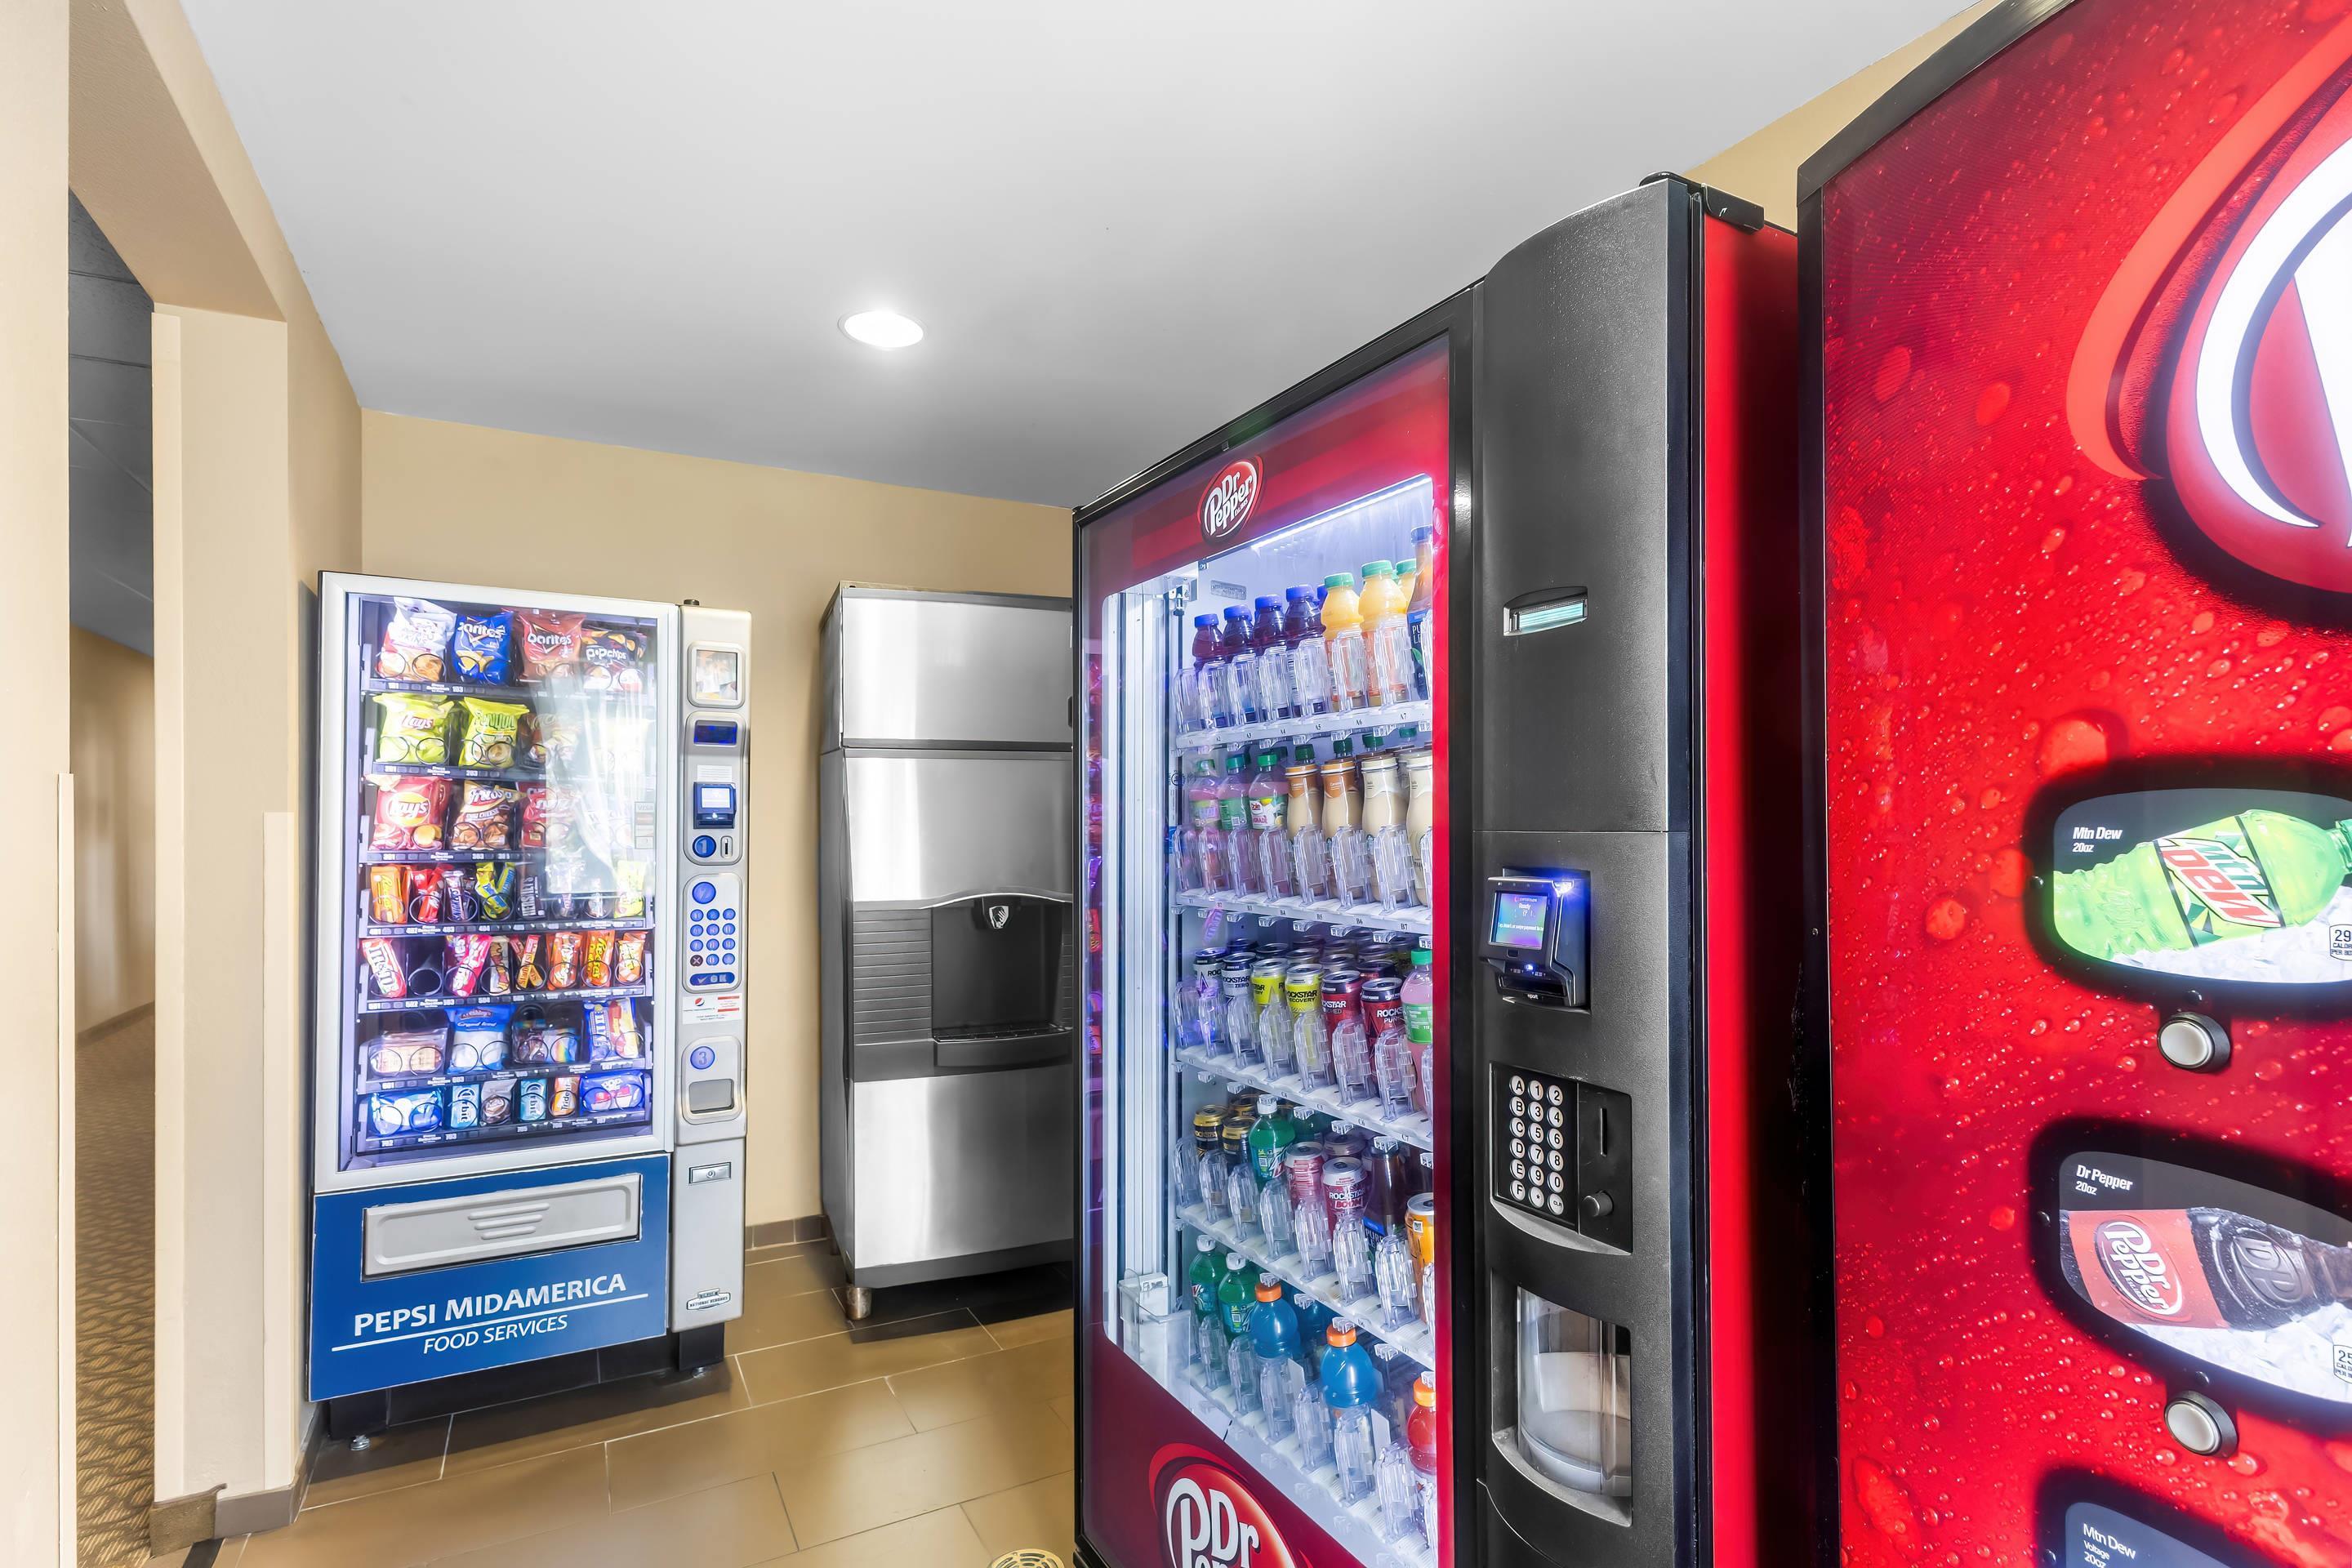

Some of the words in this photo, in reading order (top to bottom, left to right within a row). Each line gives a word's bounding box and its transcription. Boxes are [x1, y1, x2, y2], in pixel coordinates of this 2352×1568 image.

[1222, 472, 1241, 506] Dr
[1205, 475, 1253, 536] Pepper
[528, 633, 572, 646] Doritos
[2072, 826, 2095, 840] Mtn
[2096, 826, 2123, 840] Dew
[2072, 842, 2095, 853] 20oz
[1519, 902, 1531, 911] Ready
[698, 1051, 707, 1066] 3
[1516, 1080, 1523, 1091] A
[1535, 1085, 1539, 1096] 1
[560, 1084, 572, 1111] Trident
[1554, 1090, 1561, 1101] 2
[1517, 1100, 1523, 1112] B
[1535, 1106, 1541, 1117] 3
[1554, 1111, 1561, 1123] 4
[1517, 1121, 1523, 1134] C
[1535, 1127, 1541, 1138] 5
[1554, 1133, 1561, 1144] 6
[1517, 1142, 1523, 1153] D
[1535, 1148, 1541, 1160] 7
[1554, 1155, 1561, 1166] 8
[1517, 1163, 1523, 1174] E
[1535, 1169, 1541, 1181] 9
[2076, 1164, 2091, 1179] Dr
[2091, 1168, 2133, 1192] Pepper
[1517, 1184, 1523, 1195] F
[2075, 1180, 2098, 1196] 20oz
[2104, 1222, 2170, 1310] Pepper
[2133, 1252, 2172, 1290] Dr
[354, 1303, 435, 1337] PEPSI
[445, 1273, 626, 1322] MIDAMERICA
[423, 1331, 480, 1354] FOOD
[483, 1314, 568, 1343] SERVICES
[1209, 1488, 1260, 1568] Dr
[2083, 1523, 2107, 1545] Mtn
[2107, 1535, 2136, 1560] Dew
[2083, 1540, 2110, 1560] Voltage
[2084, 1552, 2107, 1568] 20oz
